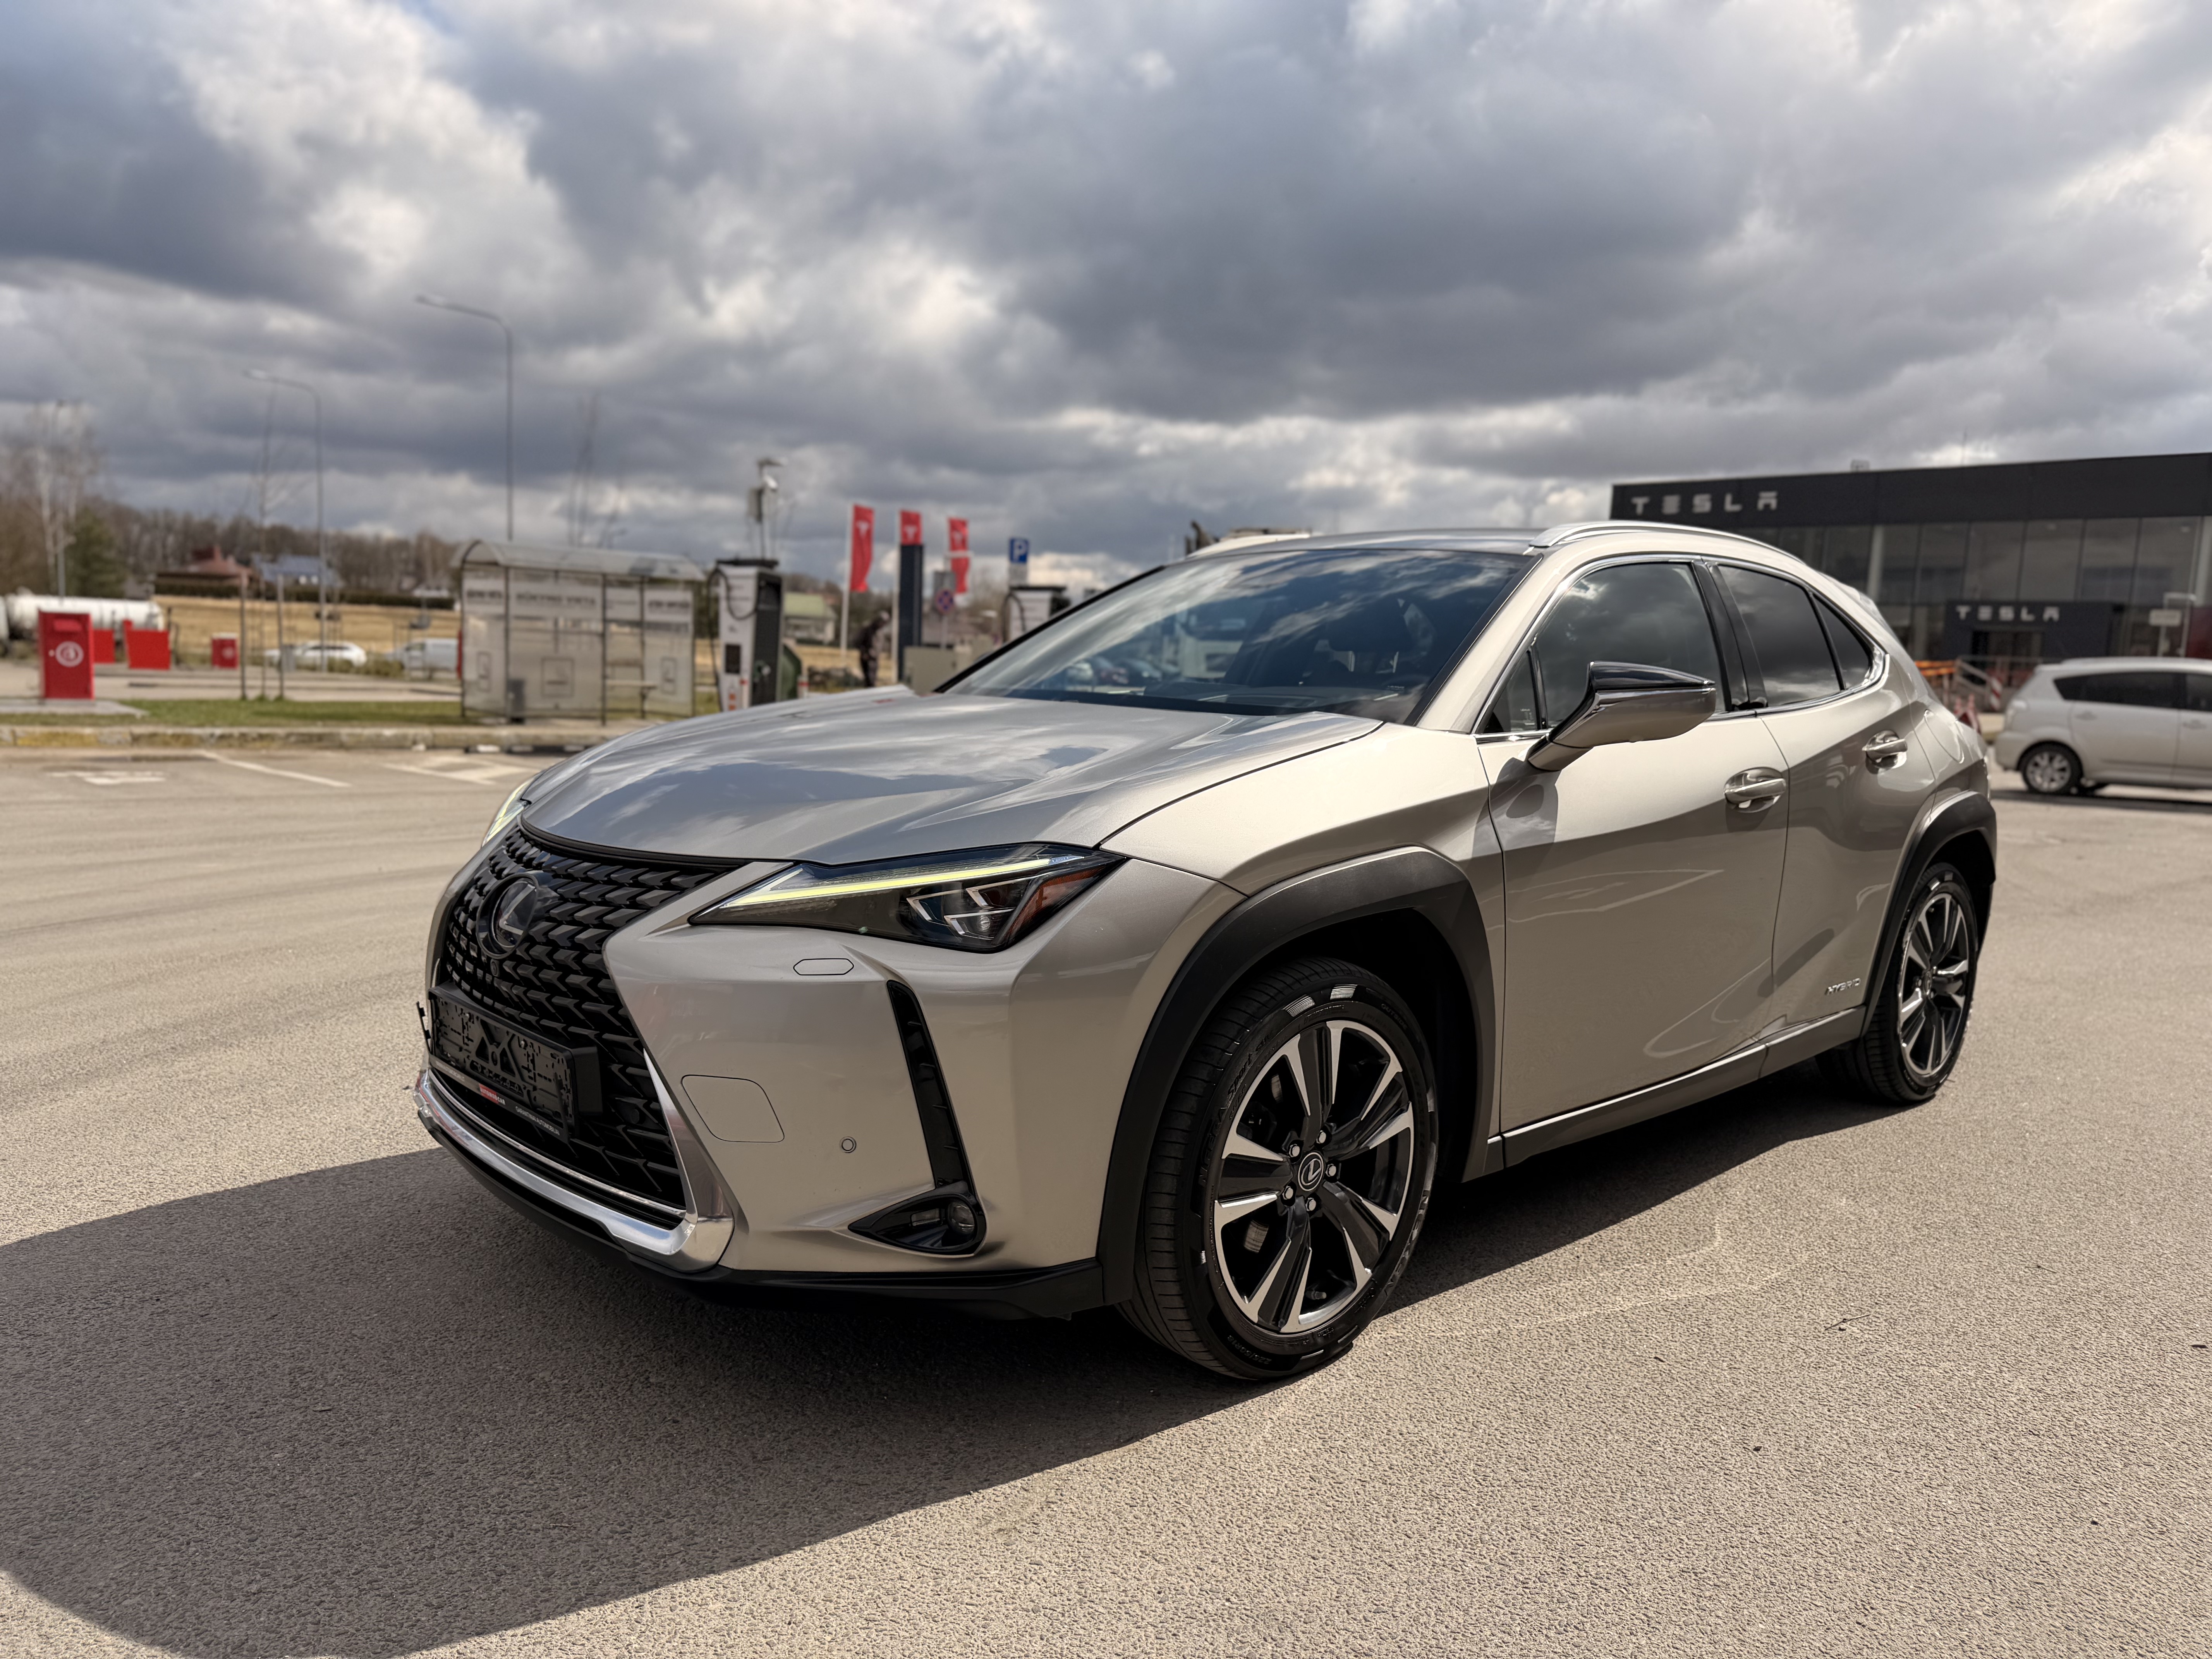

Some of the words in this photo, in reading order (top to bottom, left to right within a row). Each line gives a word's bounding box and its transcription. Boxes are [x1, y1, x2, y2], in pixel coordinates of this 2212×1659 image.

[1631, 491, 1778, 515] TESLA
[1013, 541, 1027, 562] P
[1956, 605, 2060, 622] TESLA
[1824, 978, 1861, 996] HYBRID
[1381, 1003, 1408, 1030] OUTSIDE
